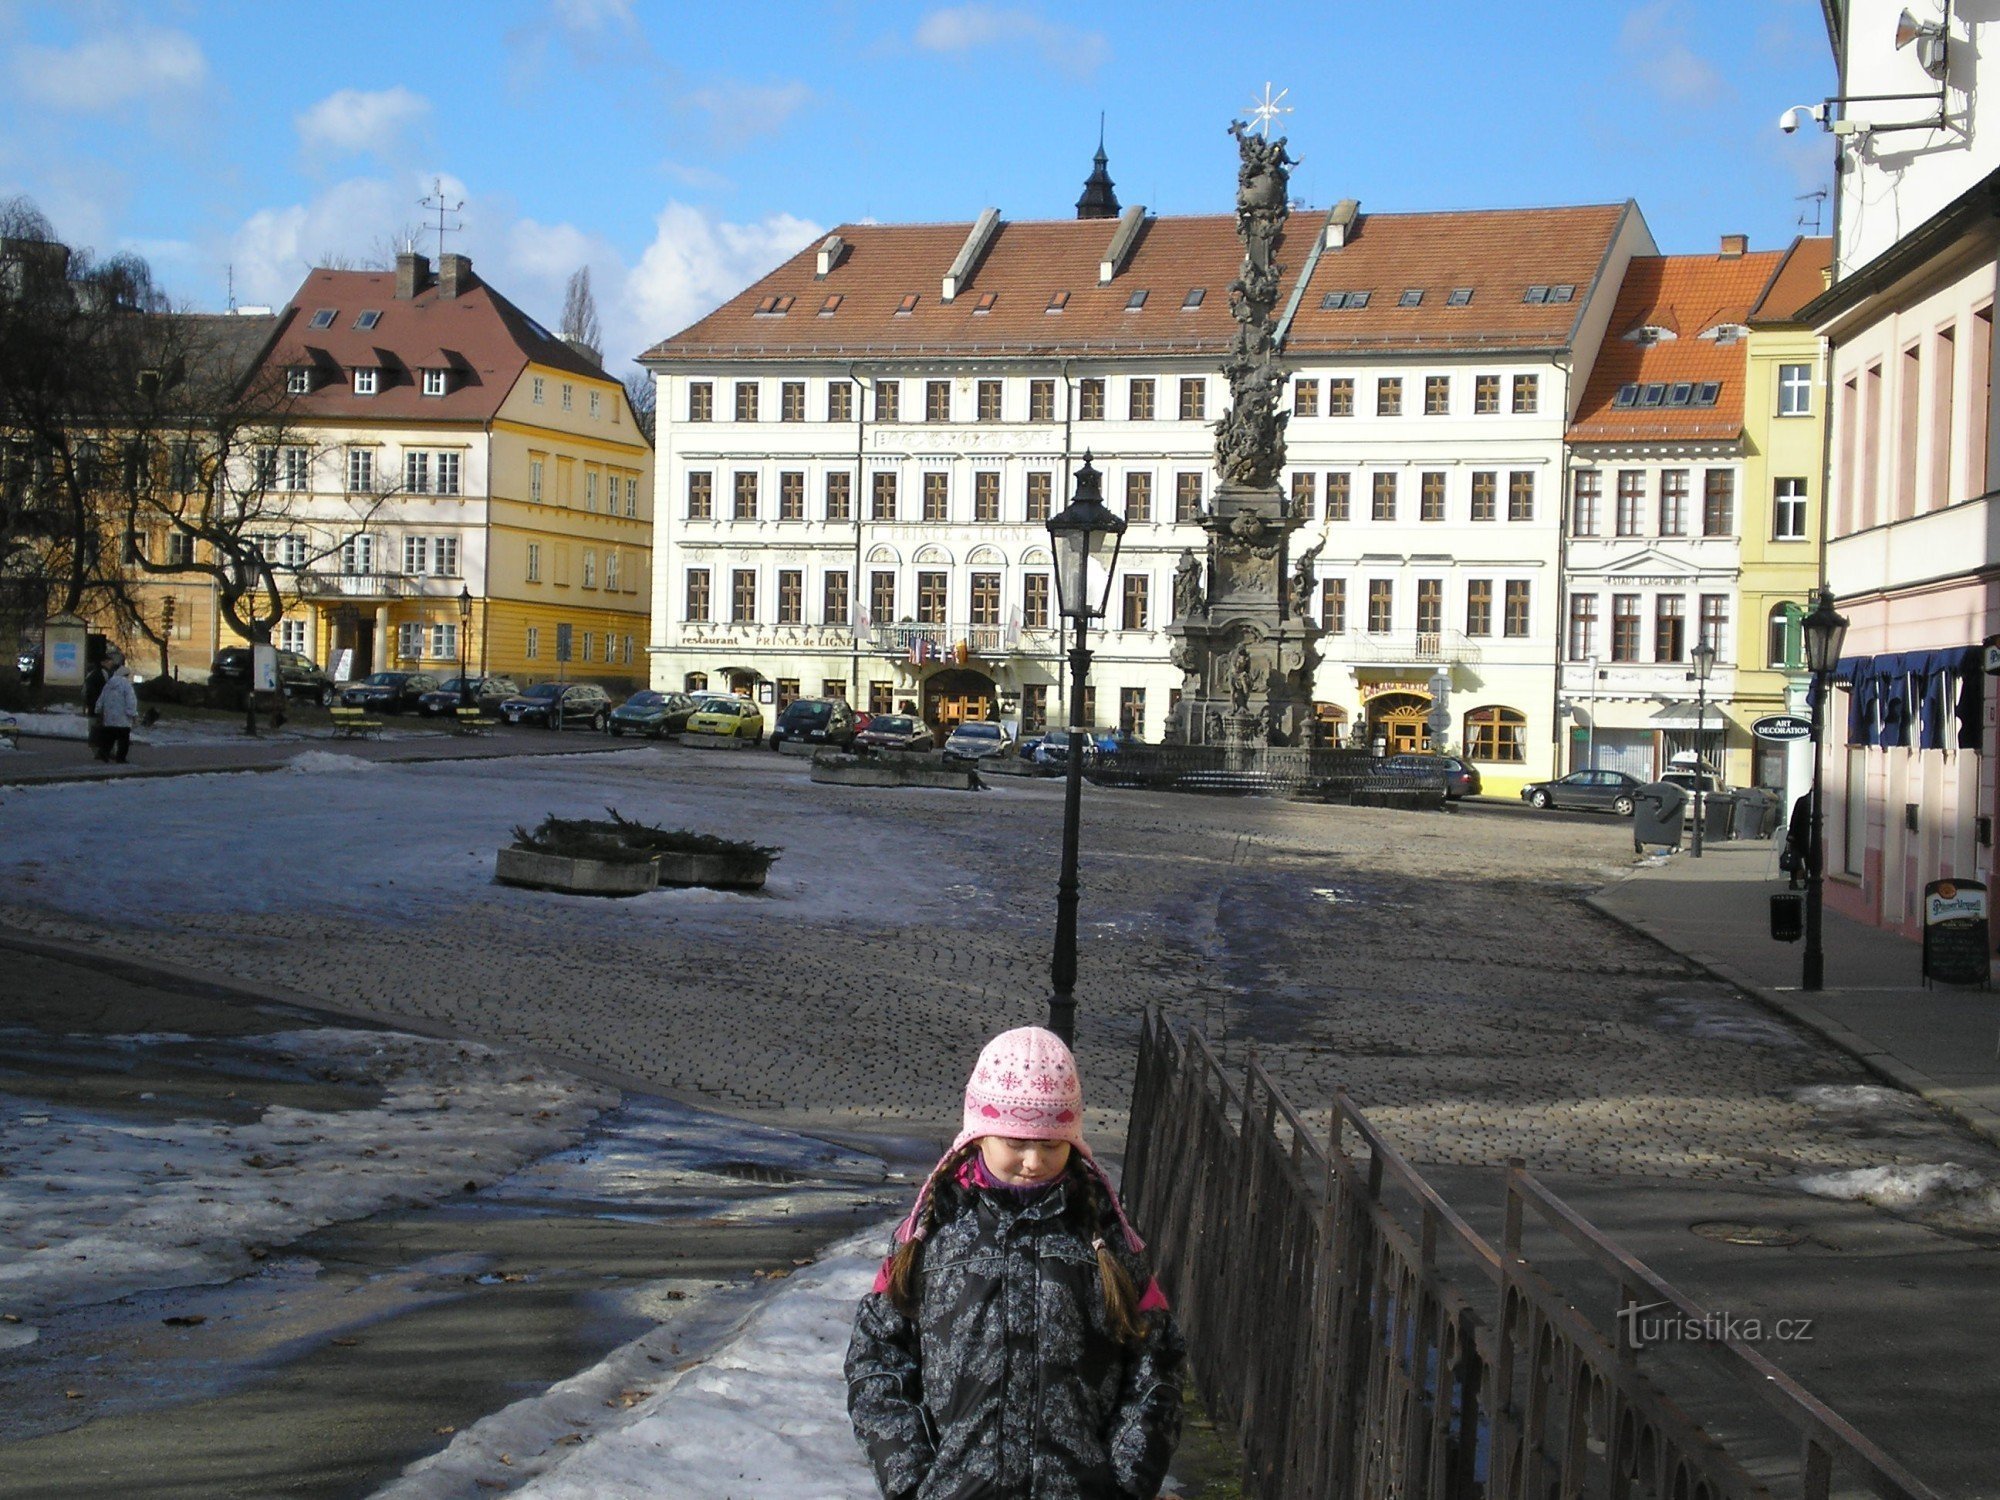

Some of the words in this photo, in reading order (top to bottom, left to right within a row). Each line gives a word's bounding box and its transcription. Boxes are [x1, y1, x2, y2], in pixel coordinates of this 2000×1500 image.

[891, 527, 952, 541] PRINCE
[979, 527, 1033, 541] LIGNE
[682, 636, 739, 645] restaurant
[756, 637, 801, 646] PRINCE
[803, 637, 815, 647] de
[818, 637, 854, 647] LIGNE
